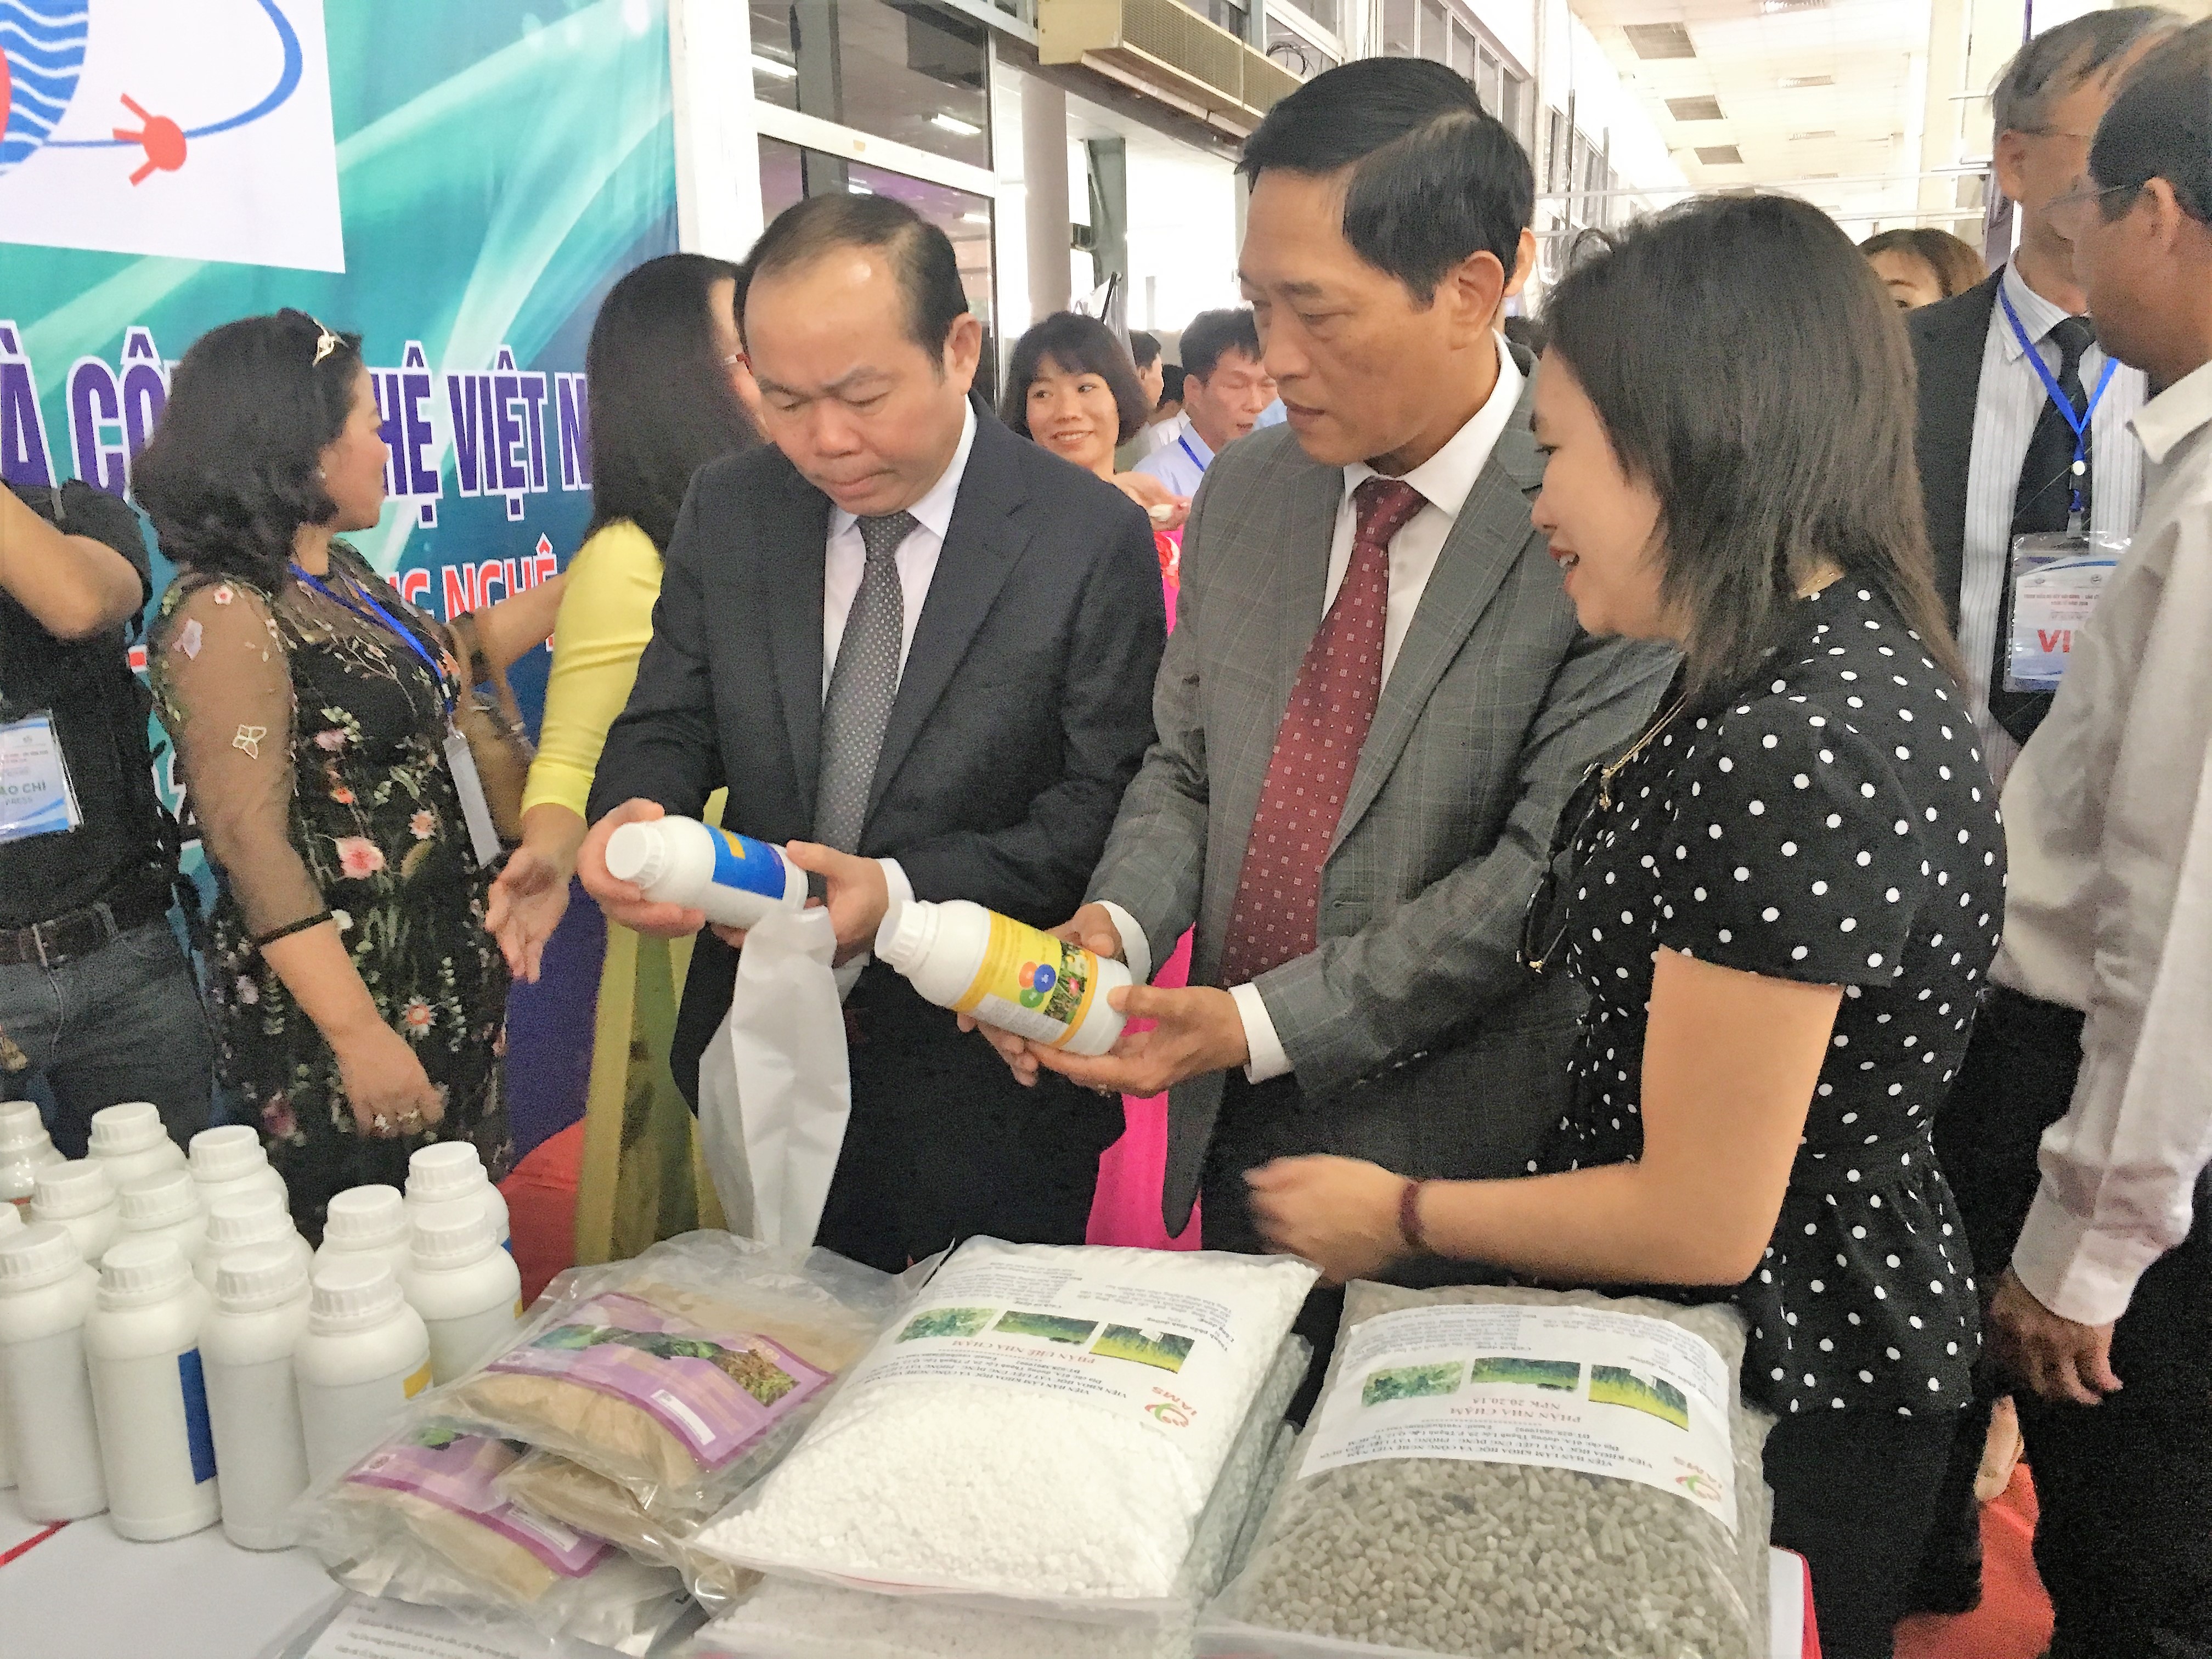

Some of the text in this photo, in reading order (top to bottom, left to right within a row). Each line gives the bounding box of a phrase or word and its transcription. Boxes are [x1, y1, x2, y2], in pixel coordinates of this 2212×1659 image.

[66, 326, 174, 504] CÔ
[369, 341, 443, 528] HỆ
[447, 345, 548, 521] VIỆT
[554, 371, 594, 492] N
[2037, 629, 2071, 653] VI
[1060, 1353, 1095, 1364] PHÂN
[1530, 1401, 1560, 1410] NPK
[1539, 1412, 1581, 1424] PHÂN
